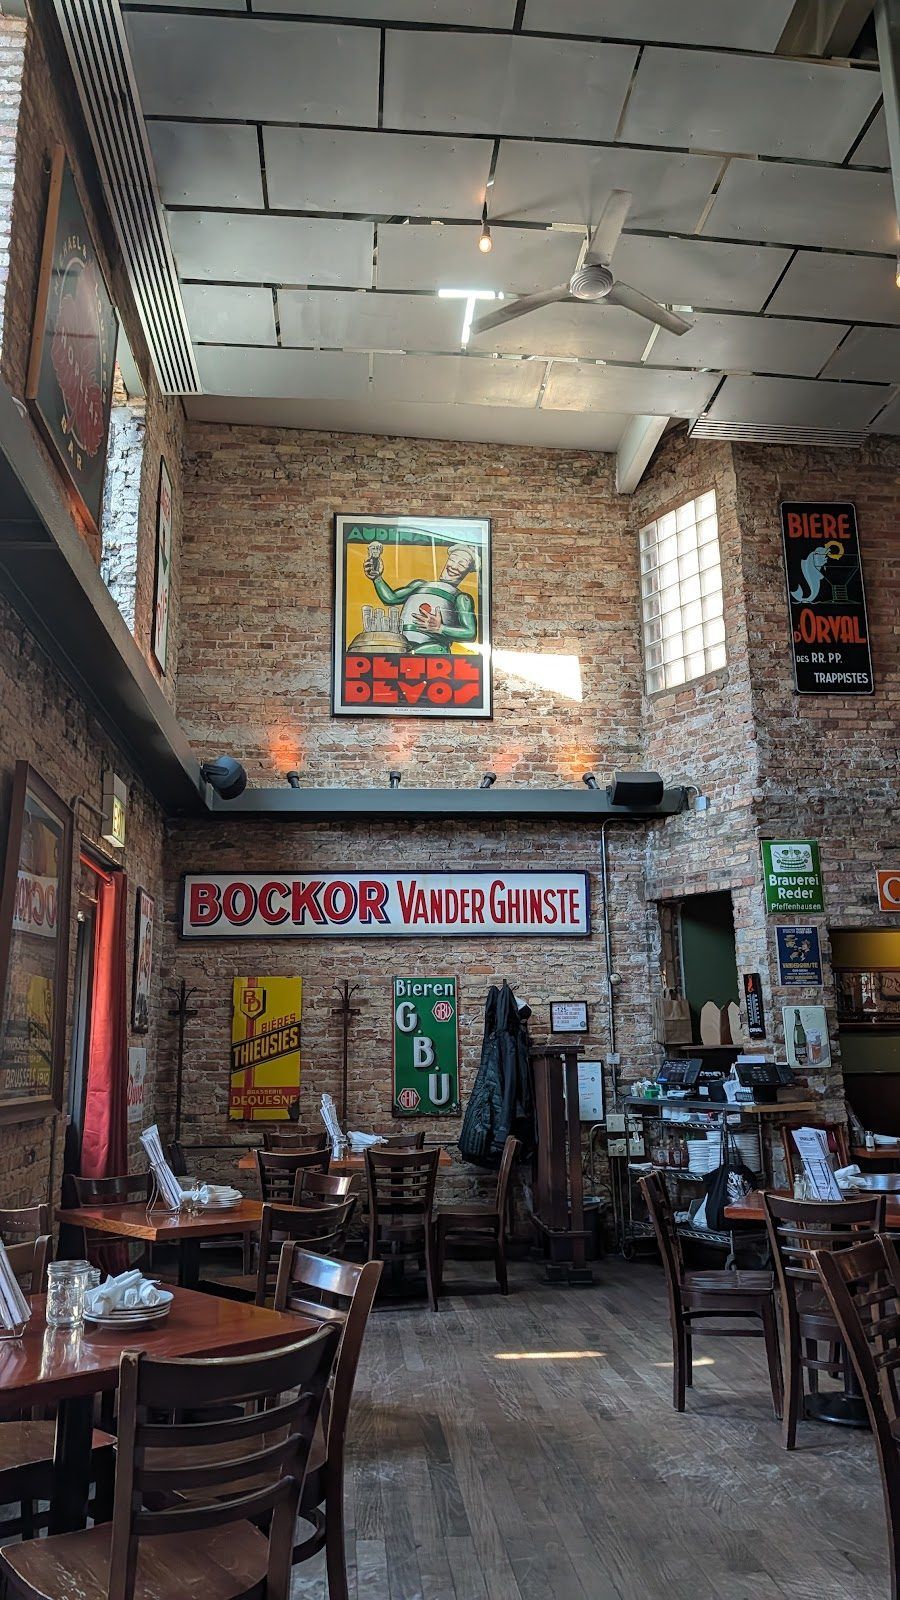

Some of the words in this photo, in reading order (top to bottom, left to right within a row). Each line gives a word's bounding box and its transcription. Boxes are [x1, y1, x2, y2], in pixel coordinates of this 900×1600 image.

[60, 413, 82, 471] BAR
[787, 512, 851, 539] BIERE
[345, 656, 480, 681] PETRE
[796, 654, 809, 663] DES
[814, 672, 869, 684] TRAPPISTES
[345, 680, 480, 704] DEVOS
[769, 874, 819, 886] Brauerei
[189, 880, 389, 926] BOCKOR
[778, 887, 814, 899] Reder
[771, 902, 822, 911] Pfeffenhausen
[396, 979, 454, 997] Bieren
[234, 1026, 299, 1068] THIEUSIES
